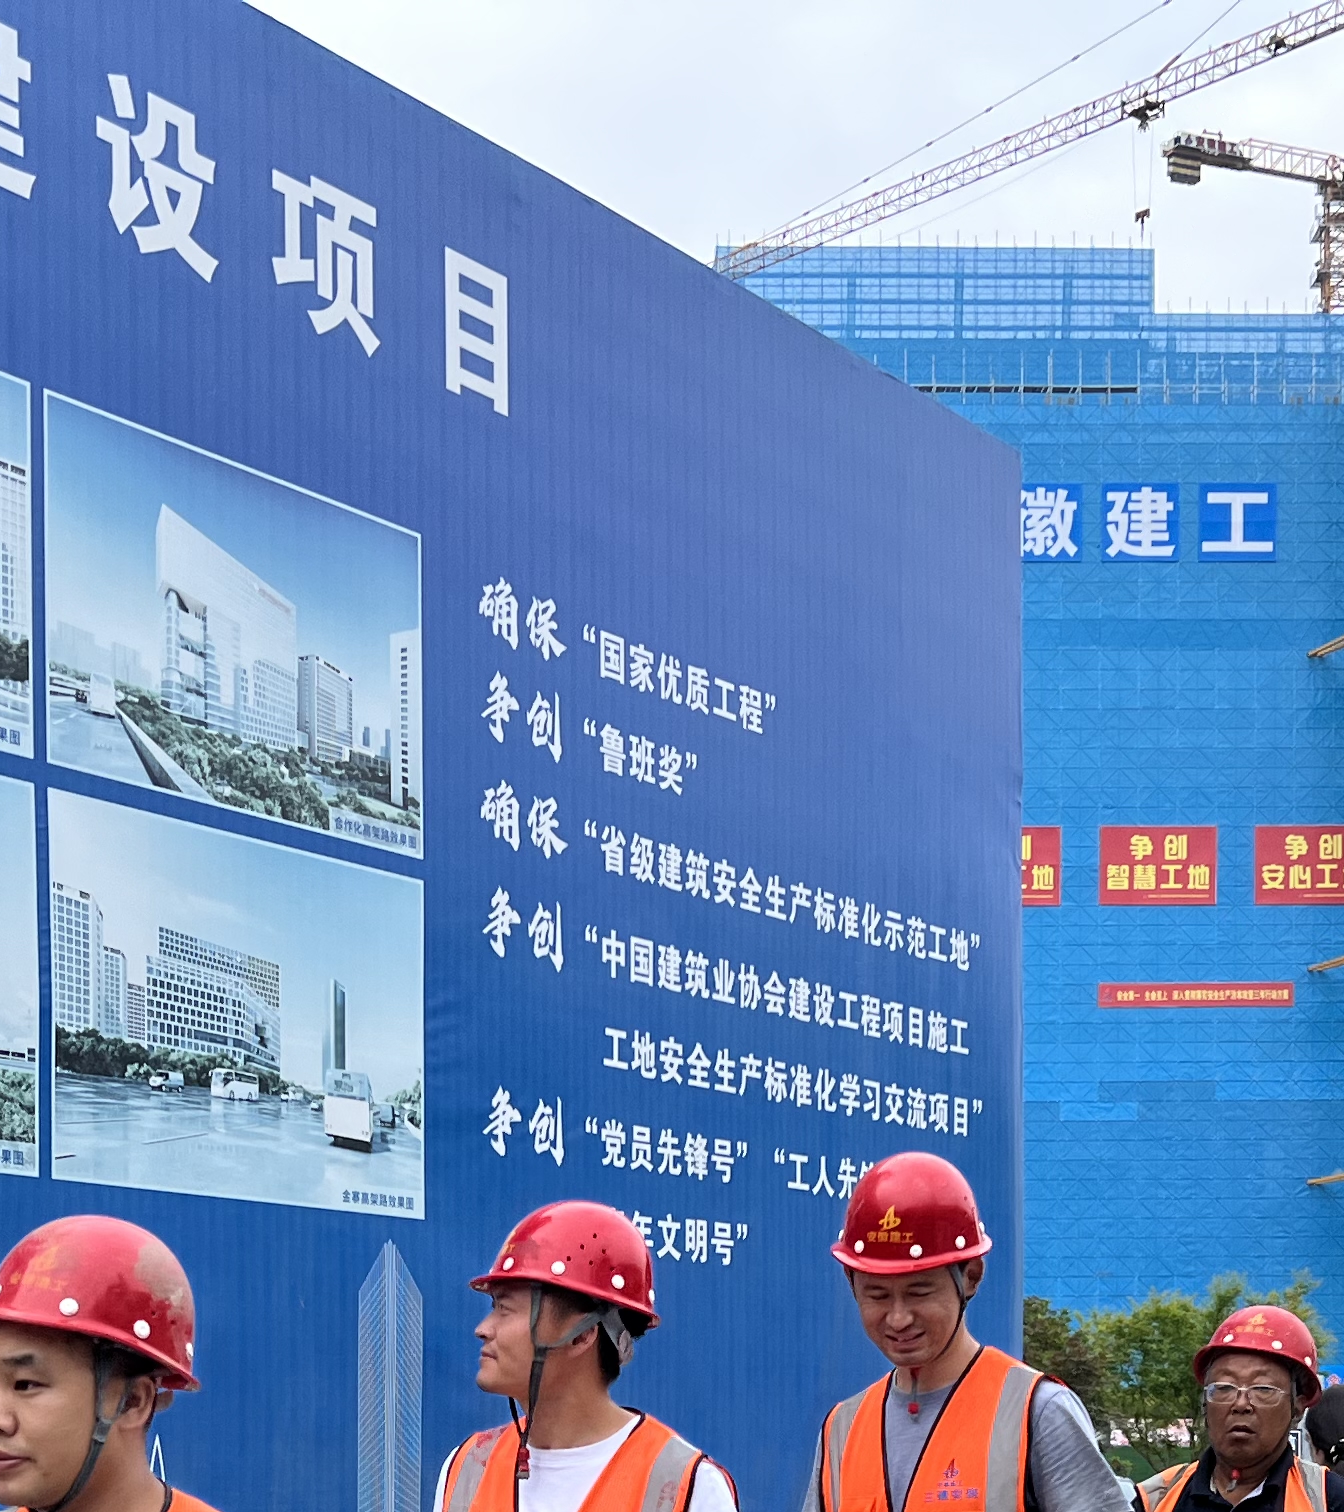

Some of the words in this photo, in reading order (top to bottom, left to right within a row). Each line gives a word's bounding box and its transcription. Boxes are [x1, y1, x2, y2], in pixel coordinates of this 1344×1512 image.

[1020, 486, 1274, 559] 徽建工
[478, 576, 568, 662] 确保
[582, 623, 778, 735] “国家优质工程”
[481, 669, 564, 764] 争创
[582, 716, 698, 796] “鲁班奖”
[480, 779, 569, 860] 确保
[583, 818, 982, 972] “省级建筑安全生产标准化示范工地”
[1021, 864, 1055, 891] 地
[1106, 863, 1211, 891] 智慧工地
[1130, 833, 1188, 861] 争创
[1284, 833, 1343, 861] 争创
[481, 885, 564, 973] 争创
[584, 923, 971, 1057] “中国建筑业协会建设工程项目施工
[602, 1026, 984, 1138] 工地安全生产标准化学习交流项目”
[482, 1084, 566, 1167] 争创
[584, 1116, 749, 1185] “党员先锋号”
[611, 1207, 749, 1267] 年文明号”
